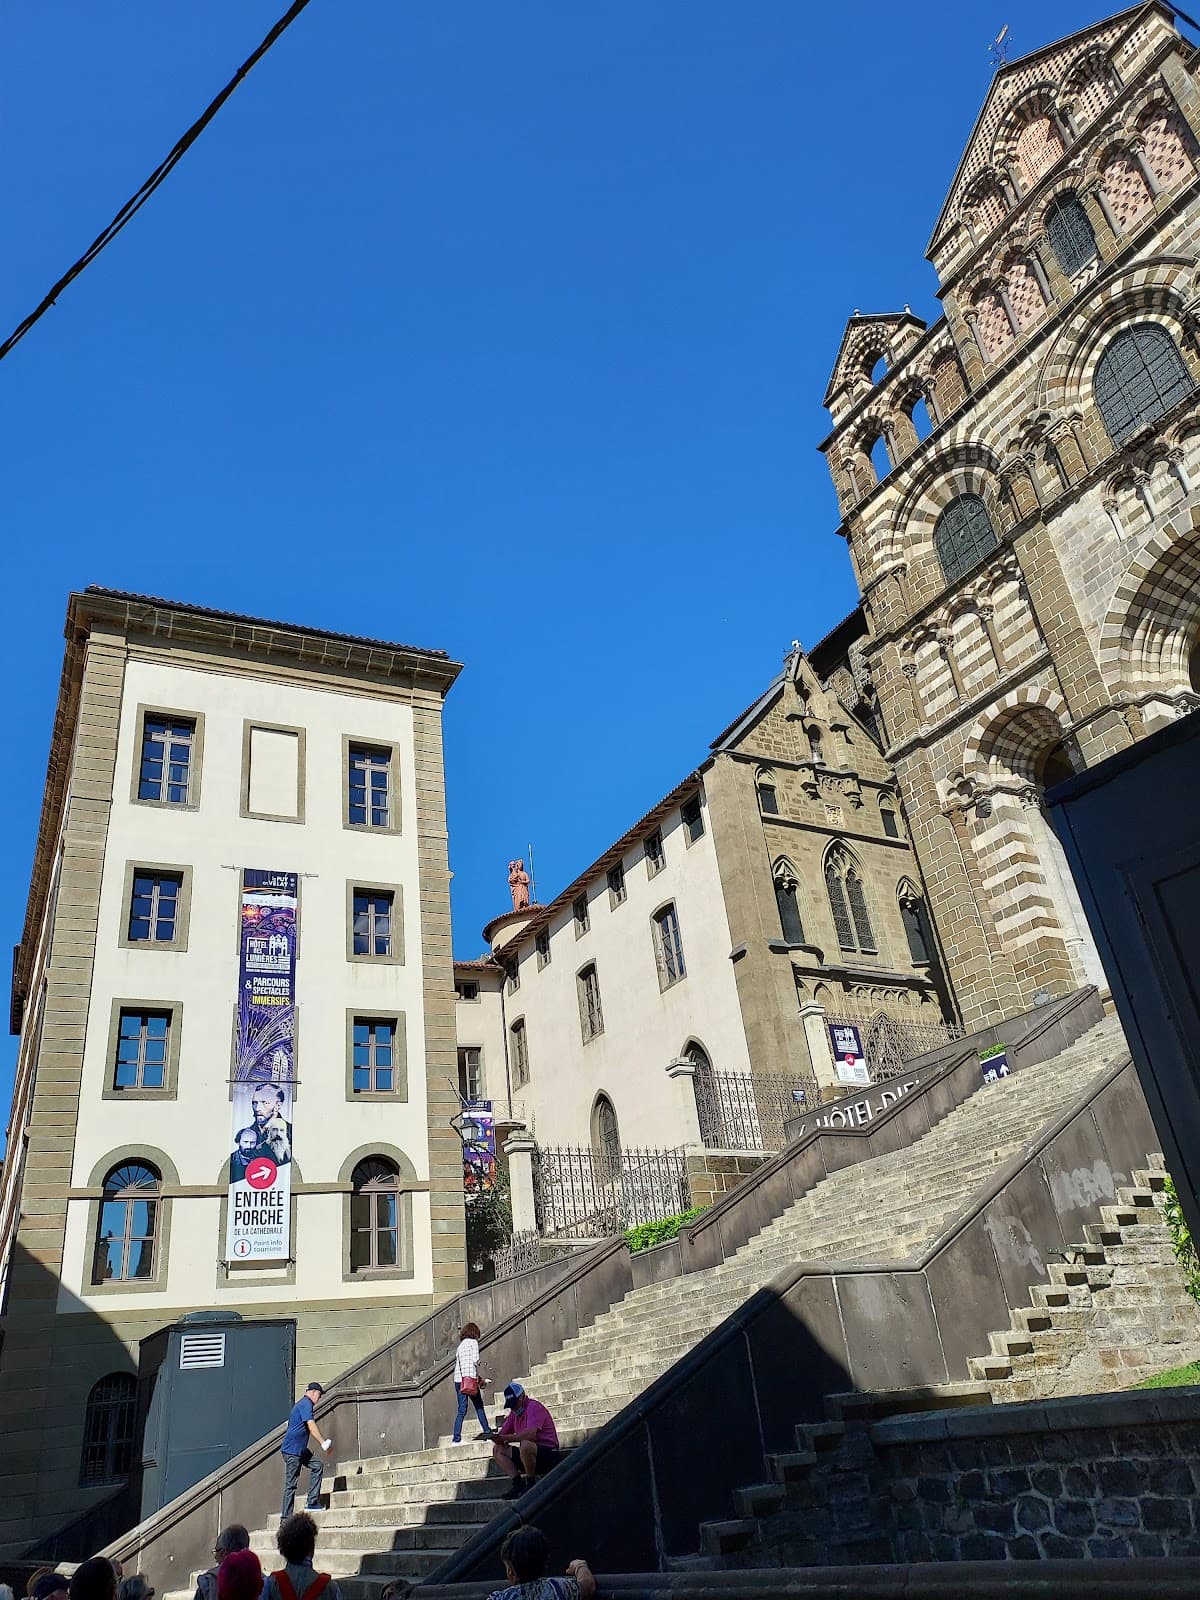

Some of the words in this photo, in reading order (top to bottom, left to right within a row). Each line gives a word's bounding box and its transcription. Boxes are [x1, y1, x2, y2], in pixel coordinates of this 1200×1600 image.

[250, 940, 268, 949] HÔTEL
[246, 953, 278, 963] LUMIÈRES
[244, 979, 252, 989] &
[253, 977, 290, 988] PARCOURS
[253, 986, 290, 995] SPECTACLES
[253, 995, 290, 1005] IMMERSIFS
[235, 1187, 284, 1208] ENTRÉE
[234, 1209, 284, 1226] PORCHE
[250, 1226, 283, 1235] CATHÉDRALE
